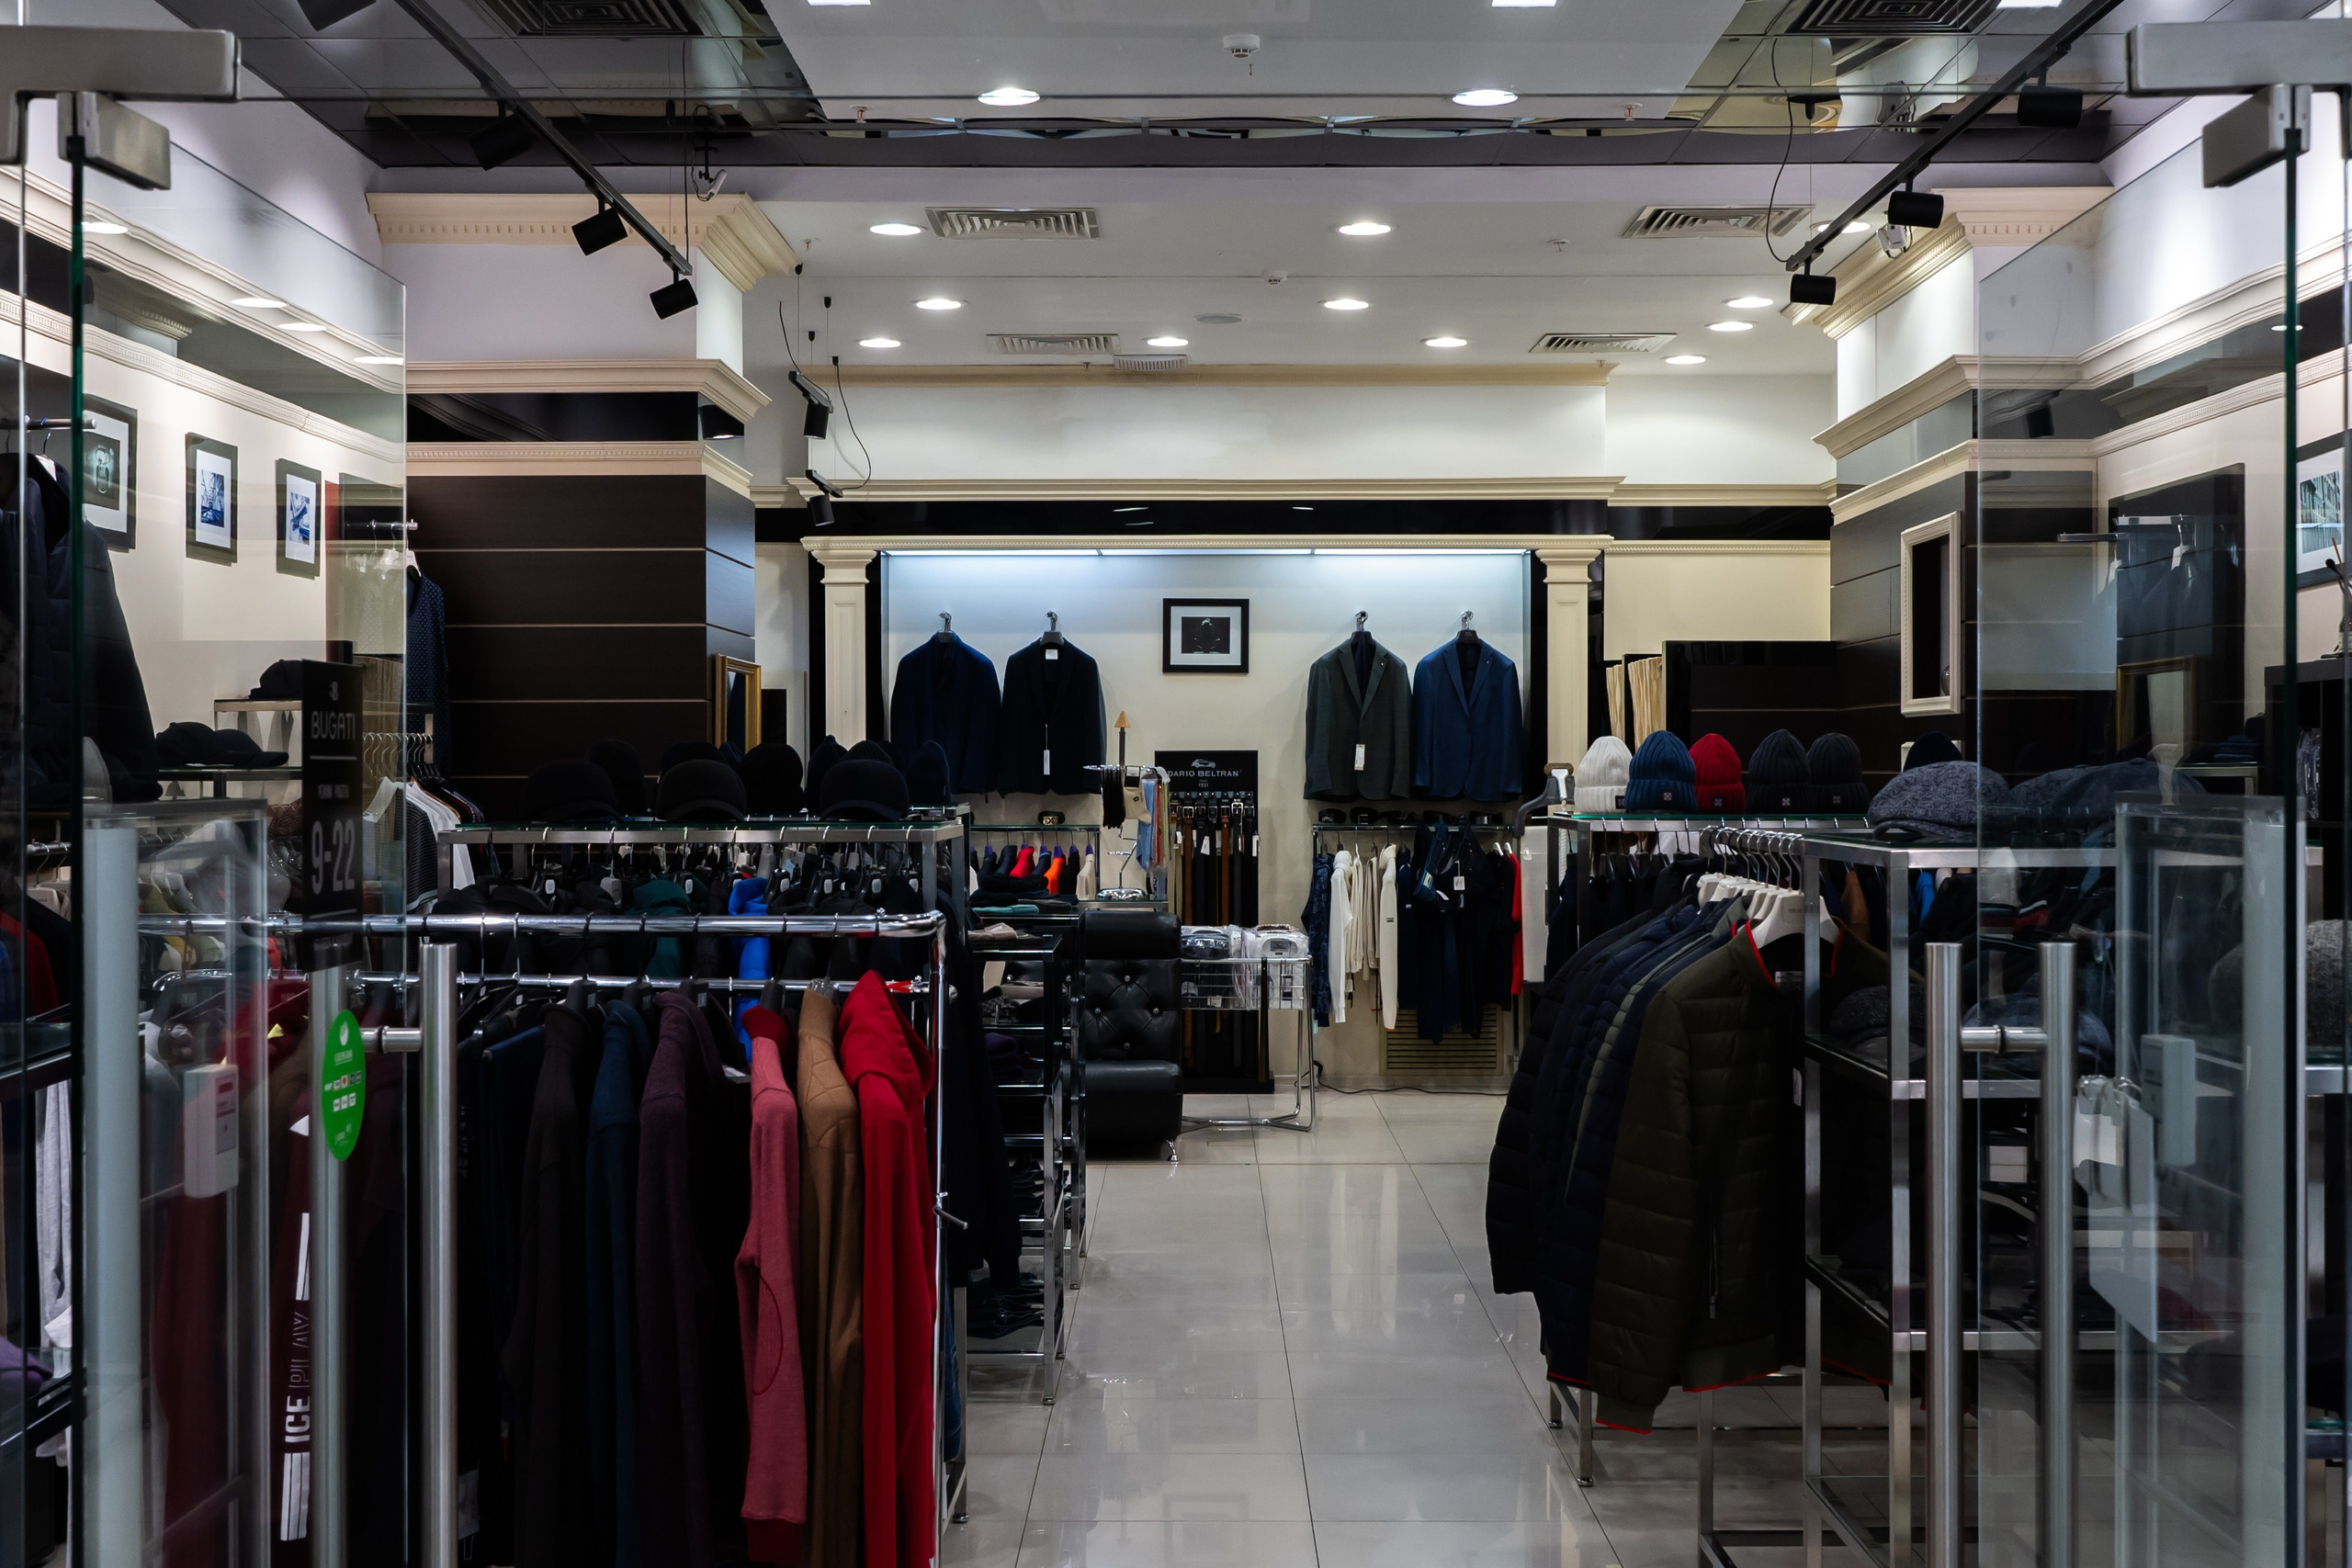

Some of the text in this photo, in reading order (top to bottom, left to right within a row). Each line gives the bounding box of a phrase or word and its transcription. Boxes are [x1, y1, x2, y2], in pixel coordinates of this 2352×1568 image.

[311, 711, 355, 740] BUGATI
[311, 818, 355, 895] 9-22
[285, 1395, 311, 1442] ICE
